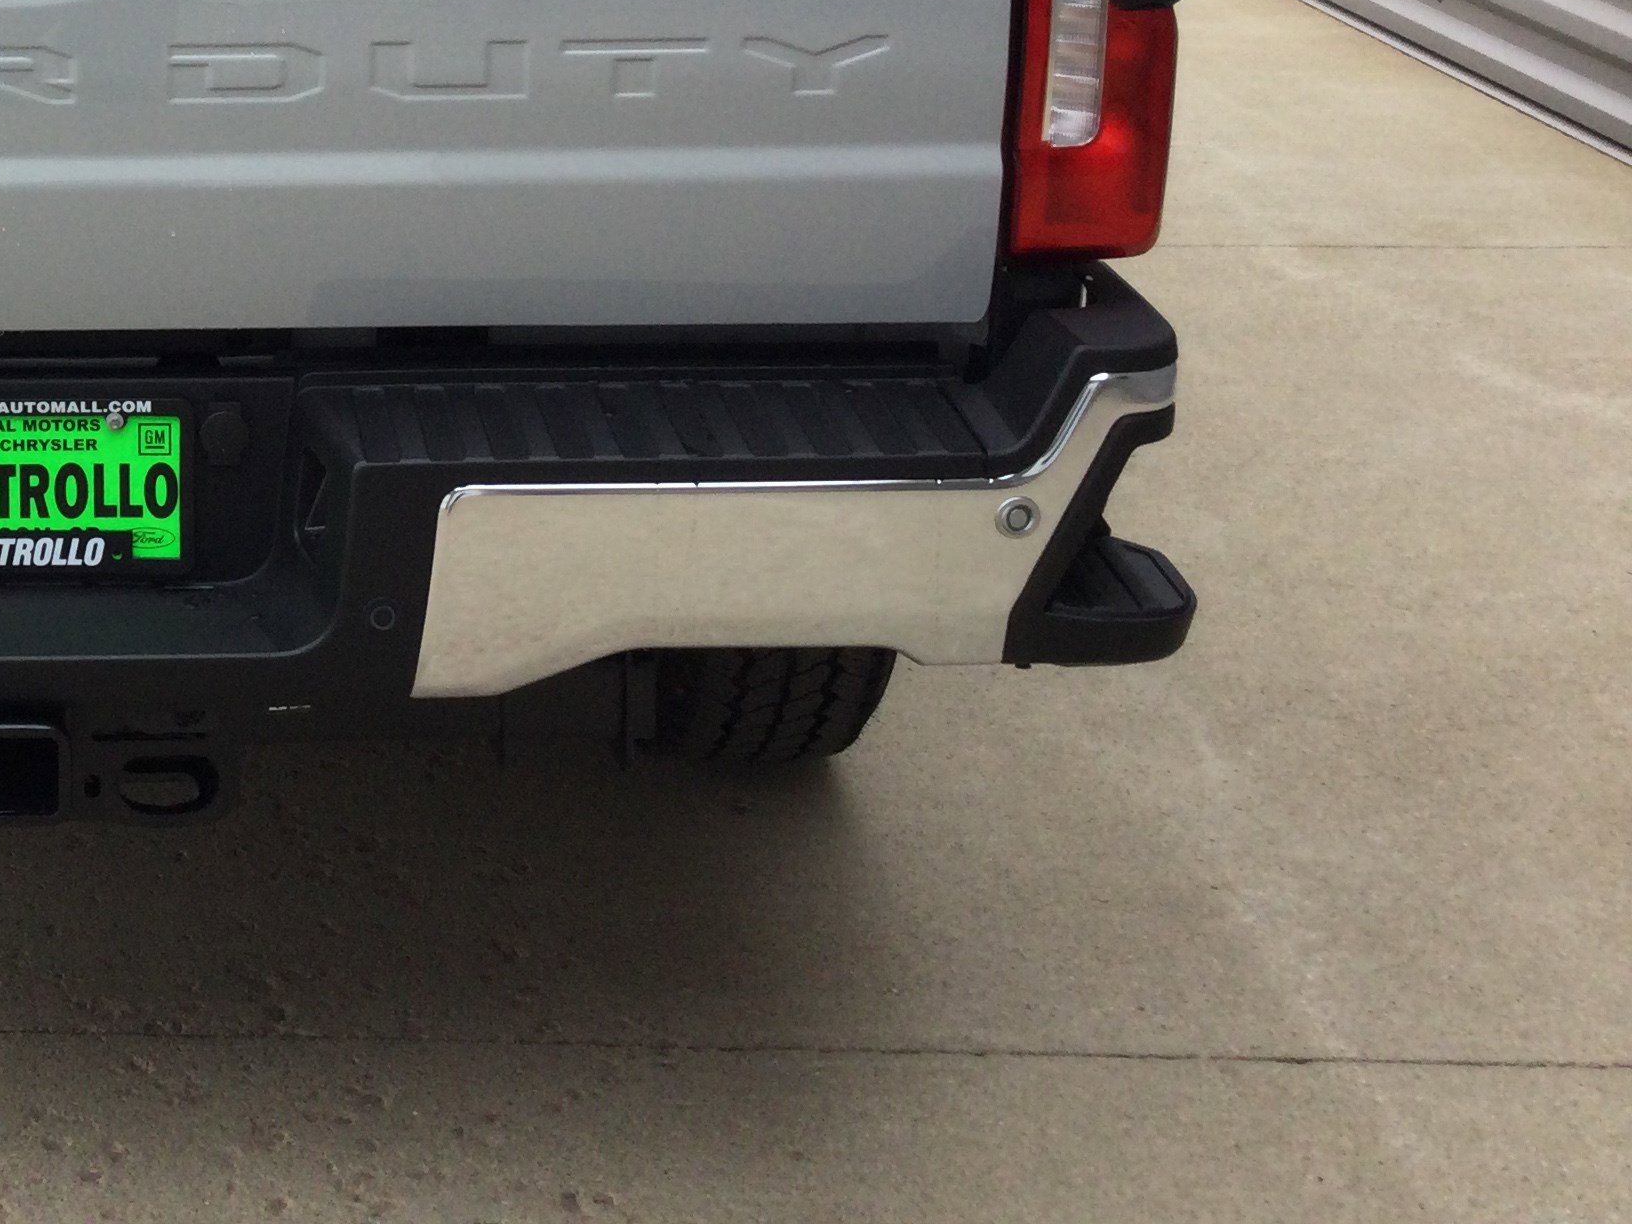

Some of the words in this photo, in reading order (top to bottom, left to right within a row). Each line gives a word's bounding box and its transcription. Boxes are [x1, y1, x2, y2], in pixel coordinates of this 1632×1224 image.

[168, 34, 890, 104] DUTY
[22, 418, 100, 432] MOTORS
[144, 429, 165, 444] GM
[0, 438, 97, 452] CHRYSLER
[133, 531, 164, 544] Ford
